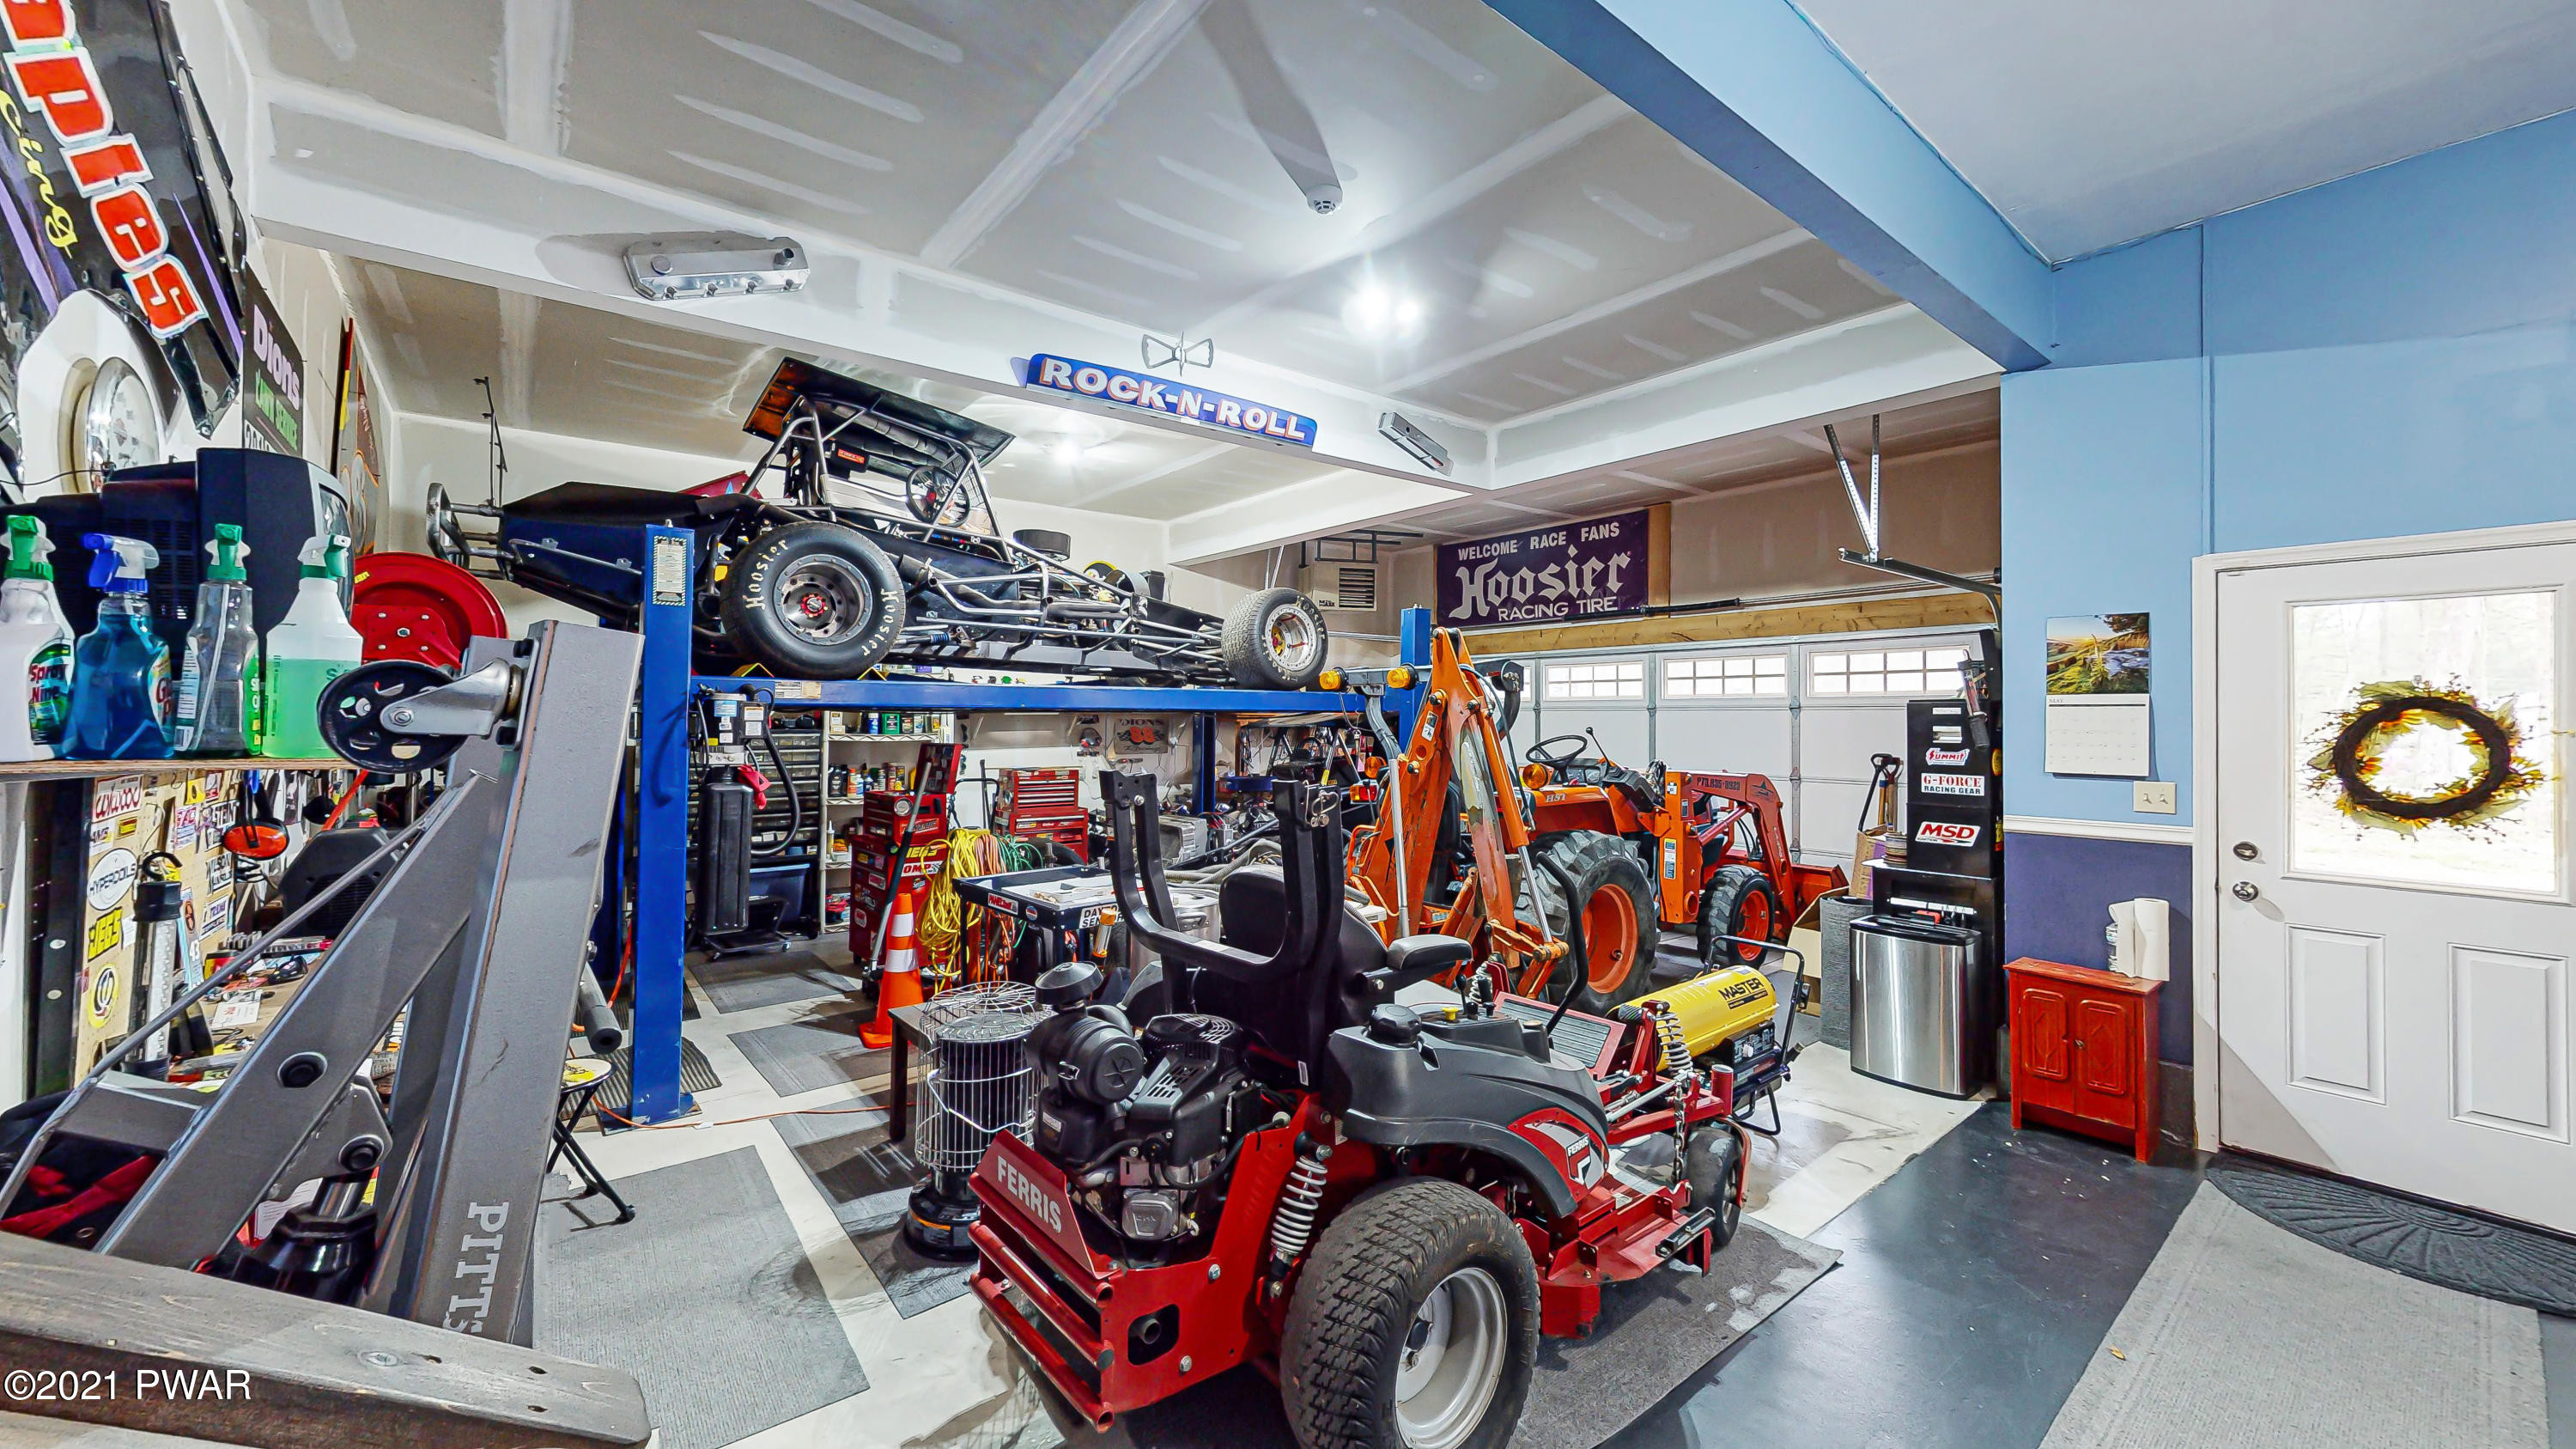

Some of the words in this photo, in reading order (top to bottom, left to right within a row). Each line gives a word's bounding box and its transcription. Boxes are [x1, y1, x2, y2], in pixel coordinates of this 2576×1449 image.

[253, 304, 300, 411] Dions
[1039, 357, 1305, 440] ROCK-N-ROLL
[1458, 539, 1518, 561] WELCOME
[1530, 532, 1567, 550] RACE
[1581, 522, 1620, 542] FANS
[743, 539, 788, 611] Hoosier
[1449, 545, 1631, 619] Hoosier
[862, 588, 900, 656] Hoosier
[1498, 602, 1569, 622] RACING
[1577, 596, 1618, 613] TIRE
[1129, 726, 1156, 744] 88
[1923, 776, 1981, 788] G-FORCE
[1921, 824, 1975, 839] MSD
[903, 863, 933, 874] OMP
[1717, 977, 1765, 1001] MASTER
[1567, 1136, 1589, 1157] FERRIS
[998, 1155, 1063, 1233] FERRIS
